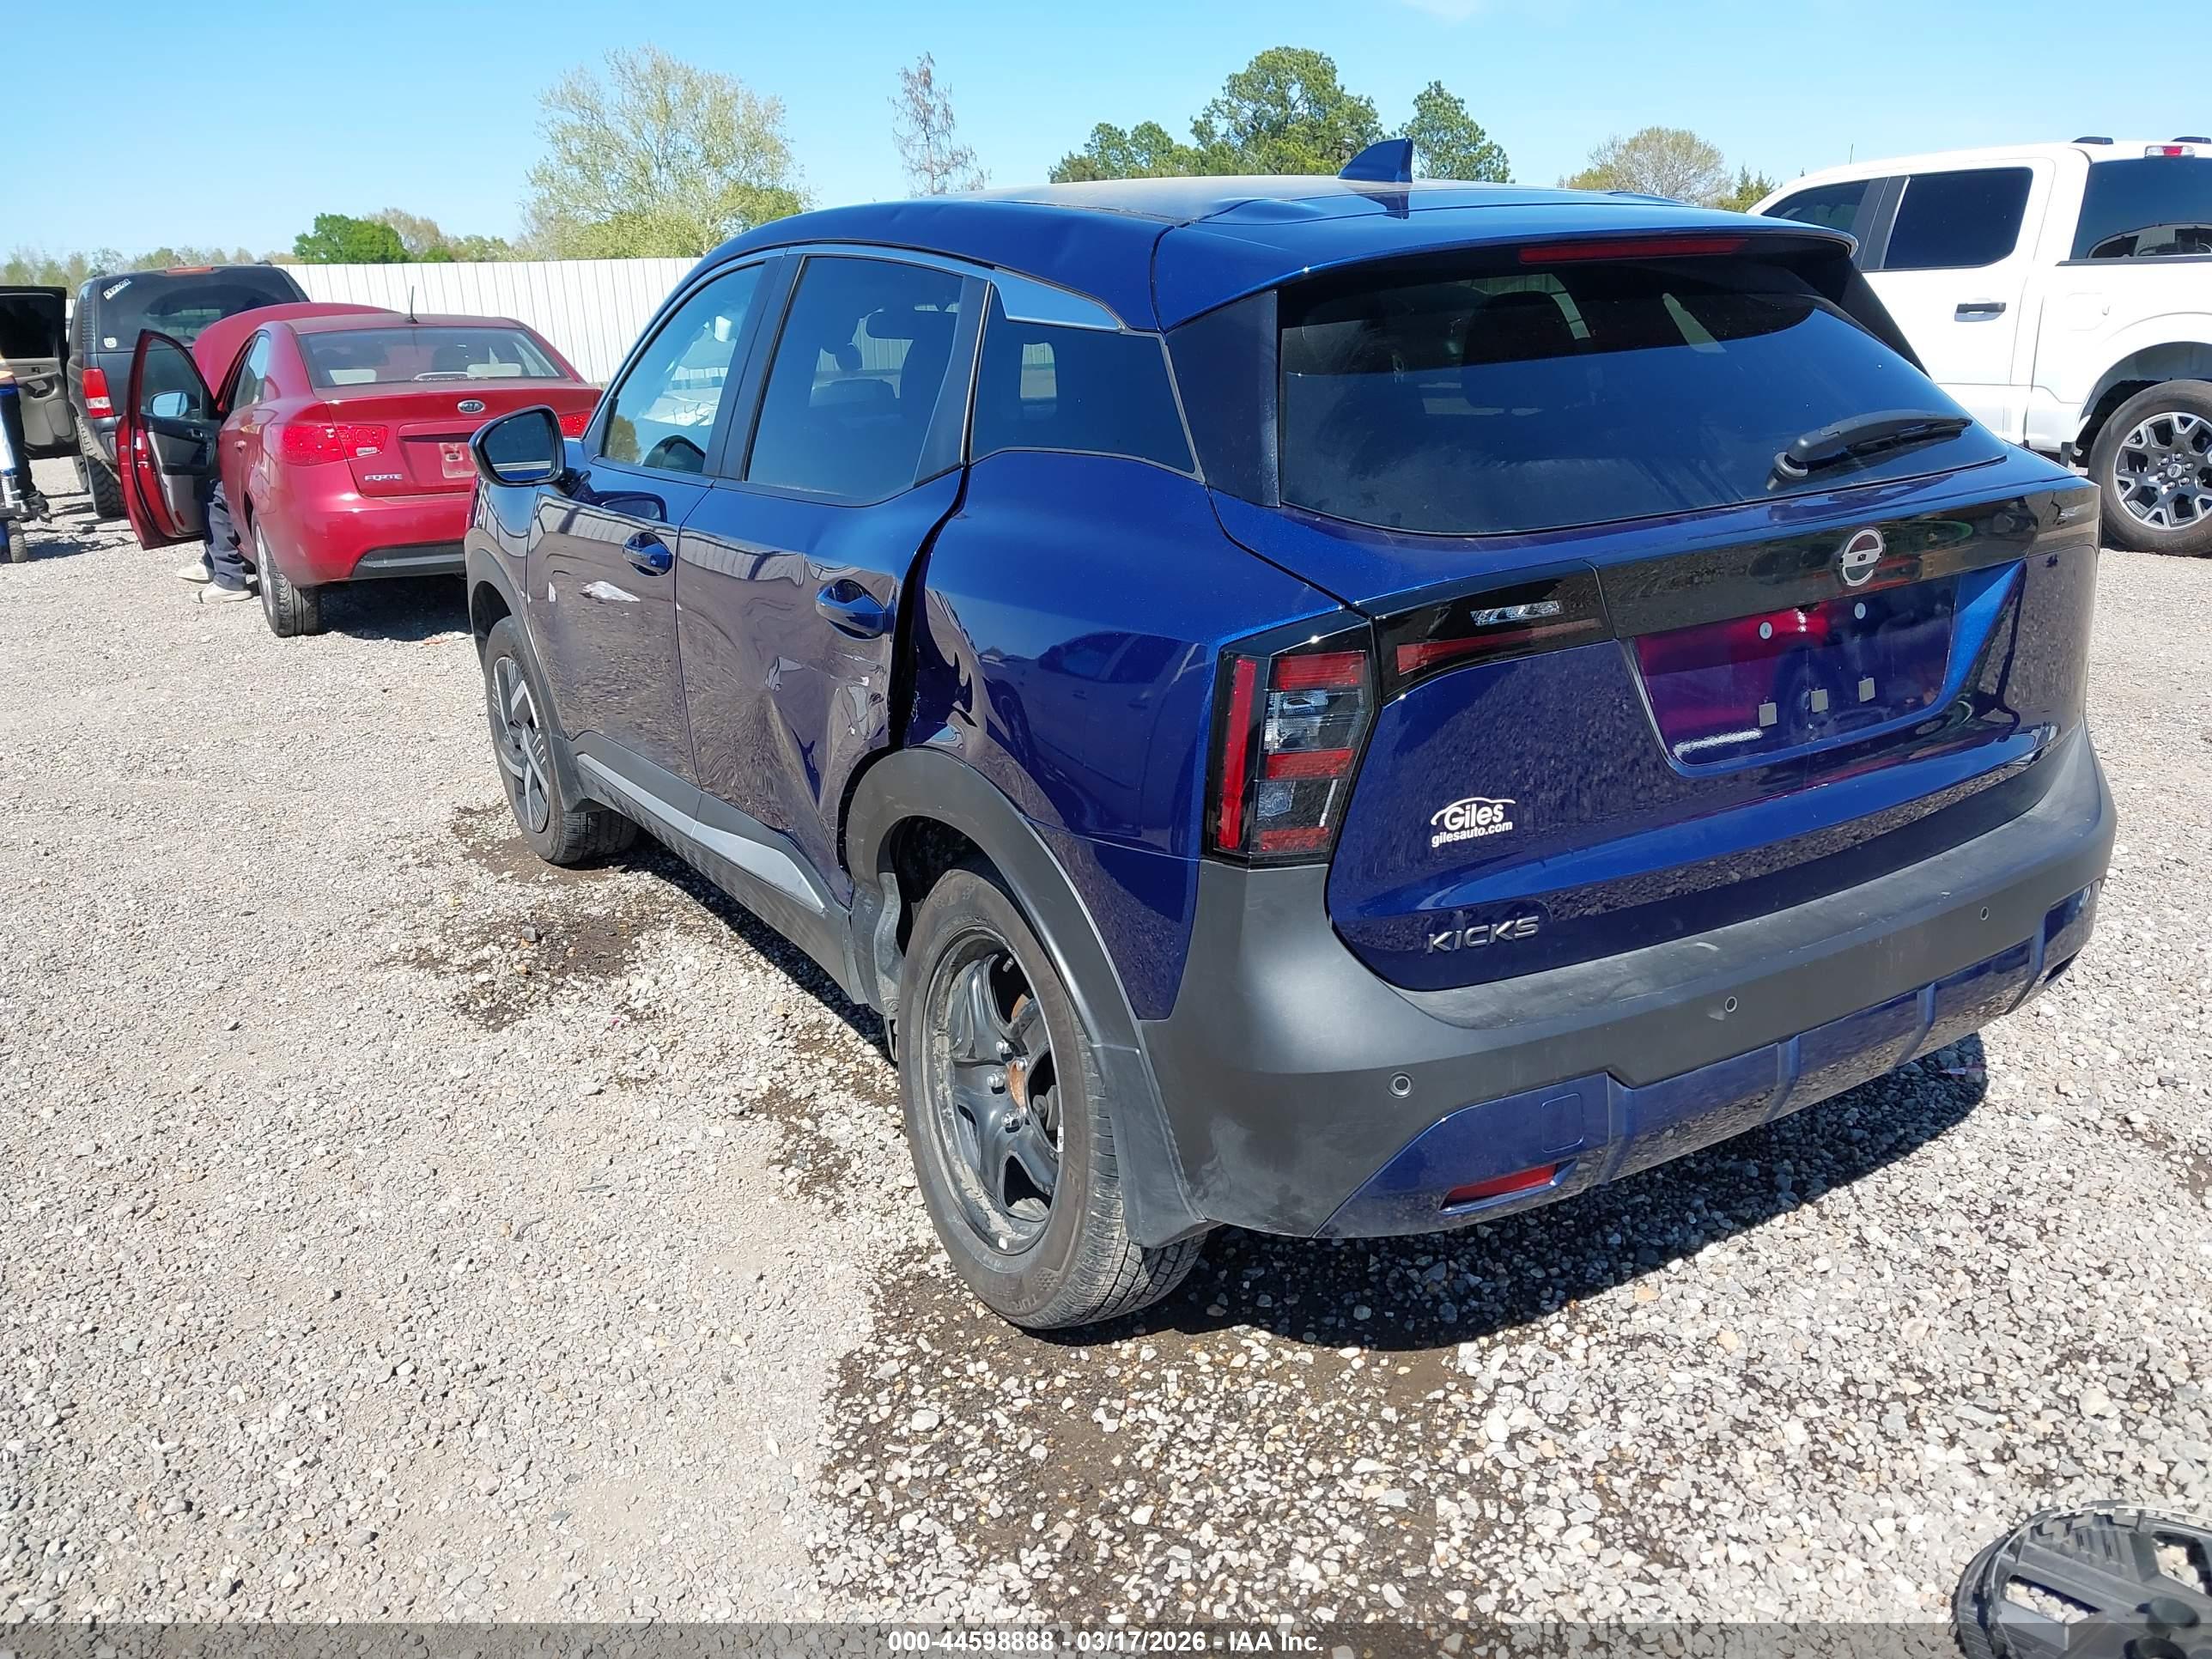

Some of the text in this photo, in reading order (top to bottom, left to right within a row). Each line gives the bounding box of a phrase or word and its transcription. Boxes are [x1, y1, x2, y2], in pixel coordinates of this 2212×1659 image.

[1443, 803, 1504, 830] Giles
[1431, 821, 1513, 848] gilesauto.com
[1427, 915, 1539, 954] KICKS
